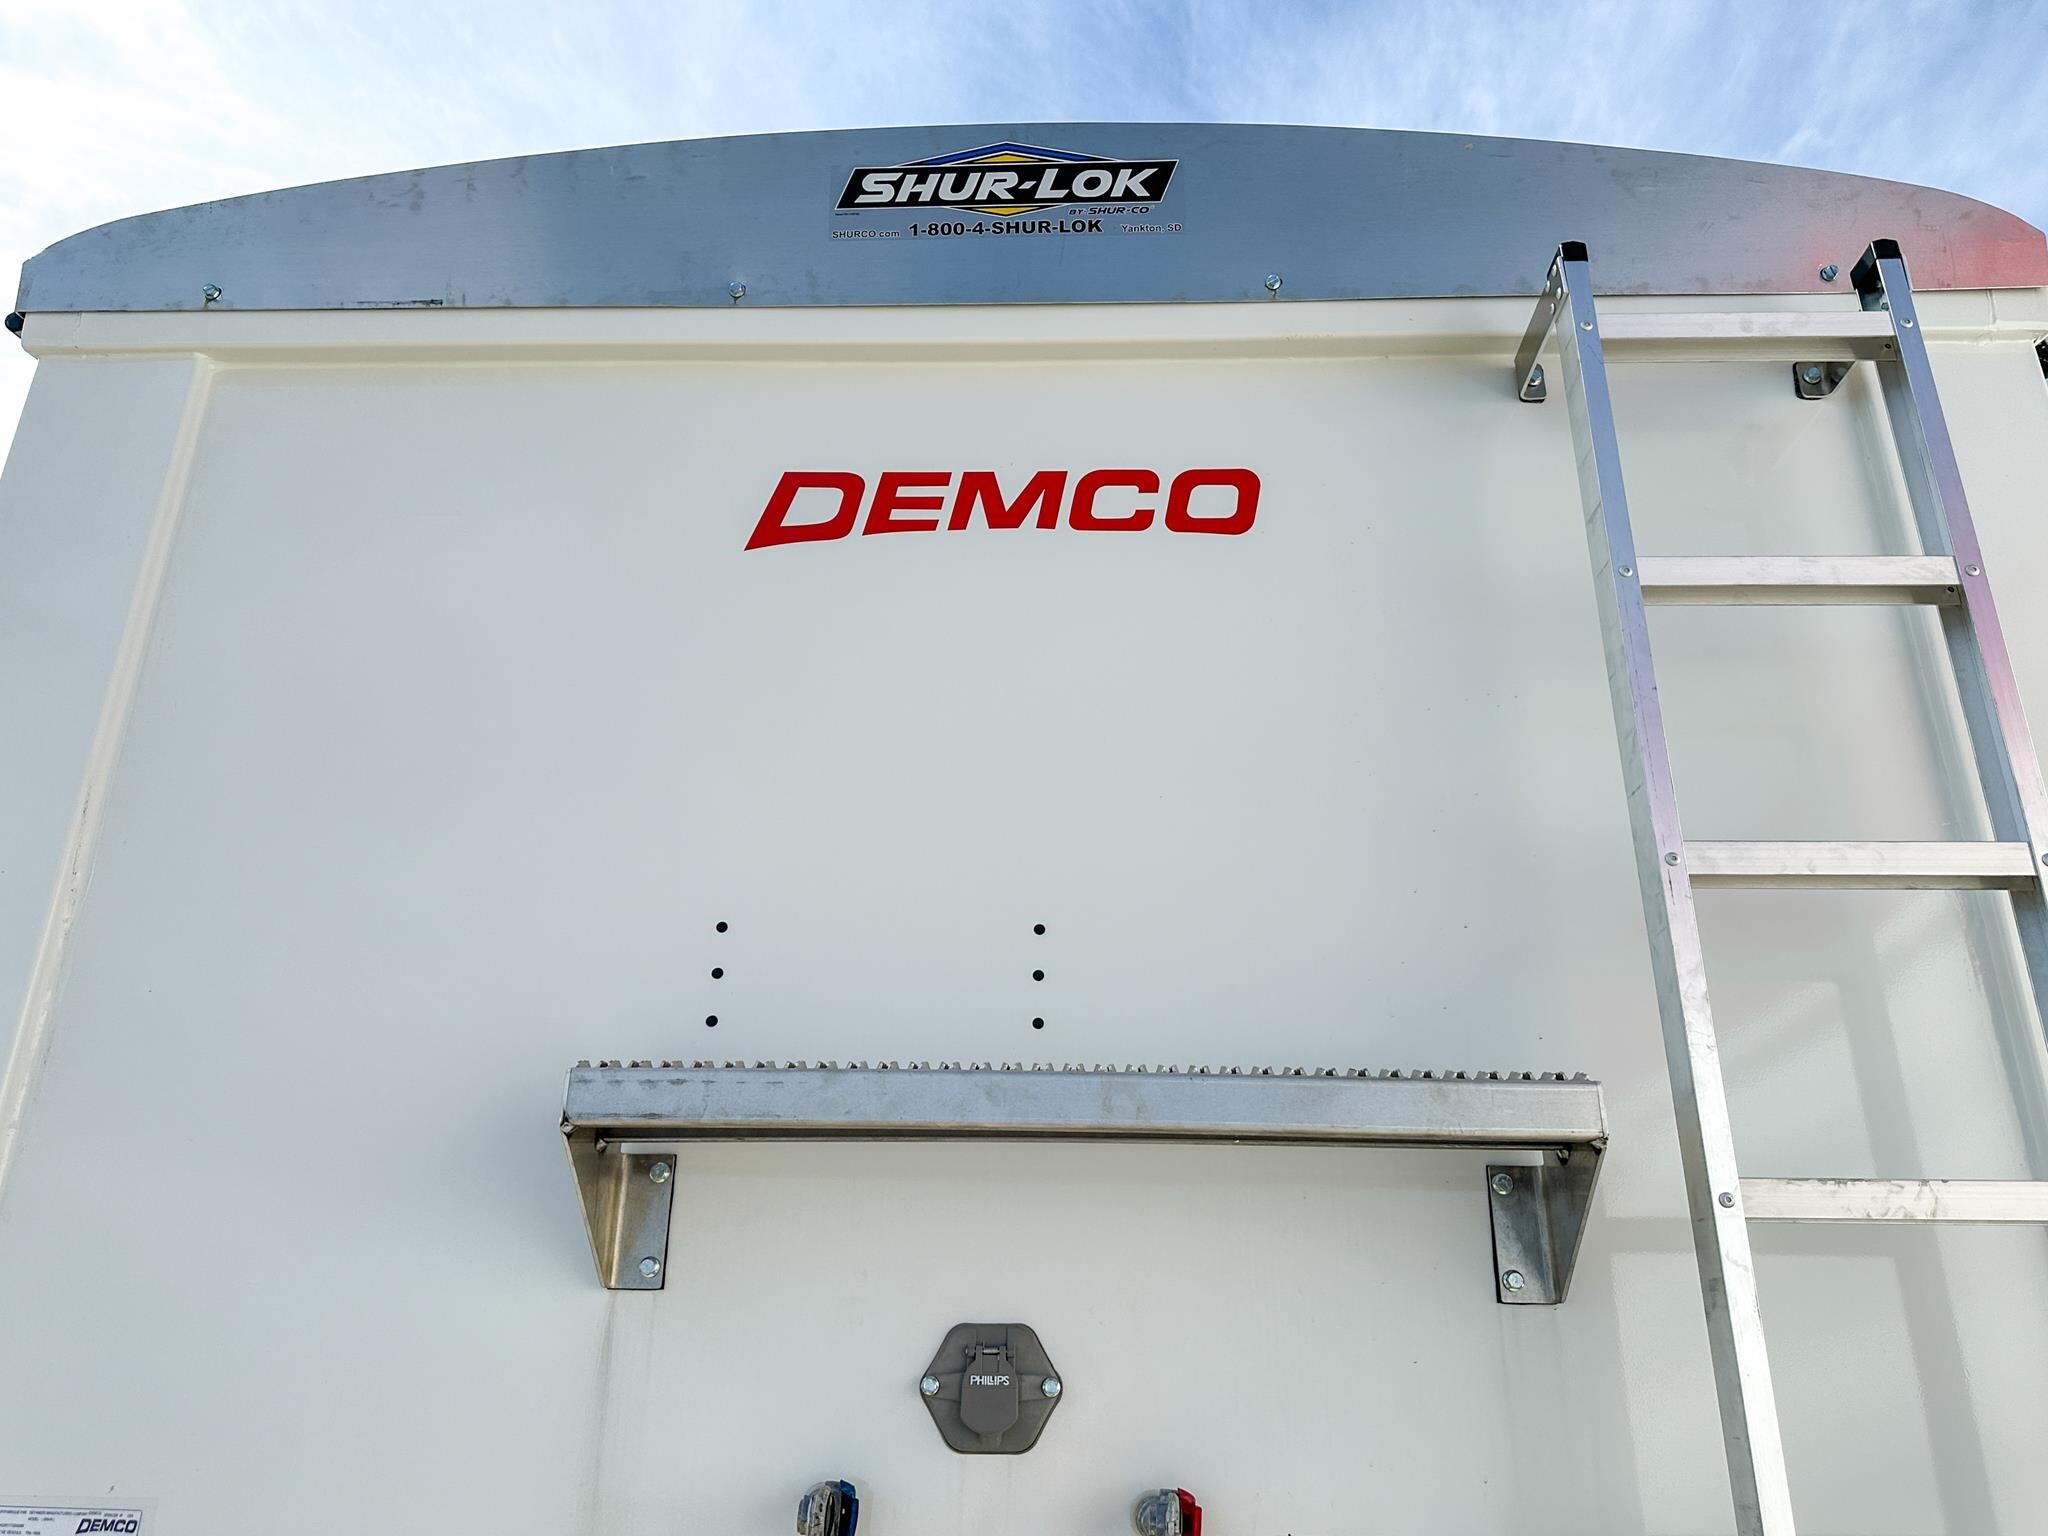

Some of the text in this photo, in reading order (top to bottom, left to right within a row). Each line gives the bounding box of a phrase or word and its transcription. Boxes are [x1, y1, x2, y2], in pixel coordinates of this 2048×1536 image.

[854, 167, 1159, 204] SHUR-LOK
[1068, 206, 1150, 216] BY SHUR-CO
[832, 230, 900, 239] SHURCO.com
[909, 219, 1103, 237] 1-800-4-SHUR-LOK
[1121, 223, 1182, 234] Yankton, SD
[745, 468, 1261, 551] DEMCO
[970, 1375, 1010, 1386] PHILLIPS
[75, 1518, 138, 1535] DEMCO
